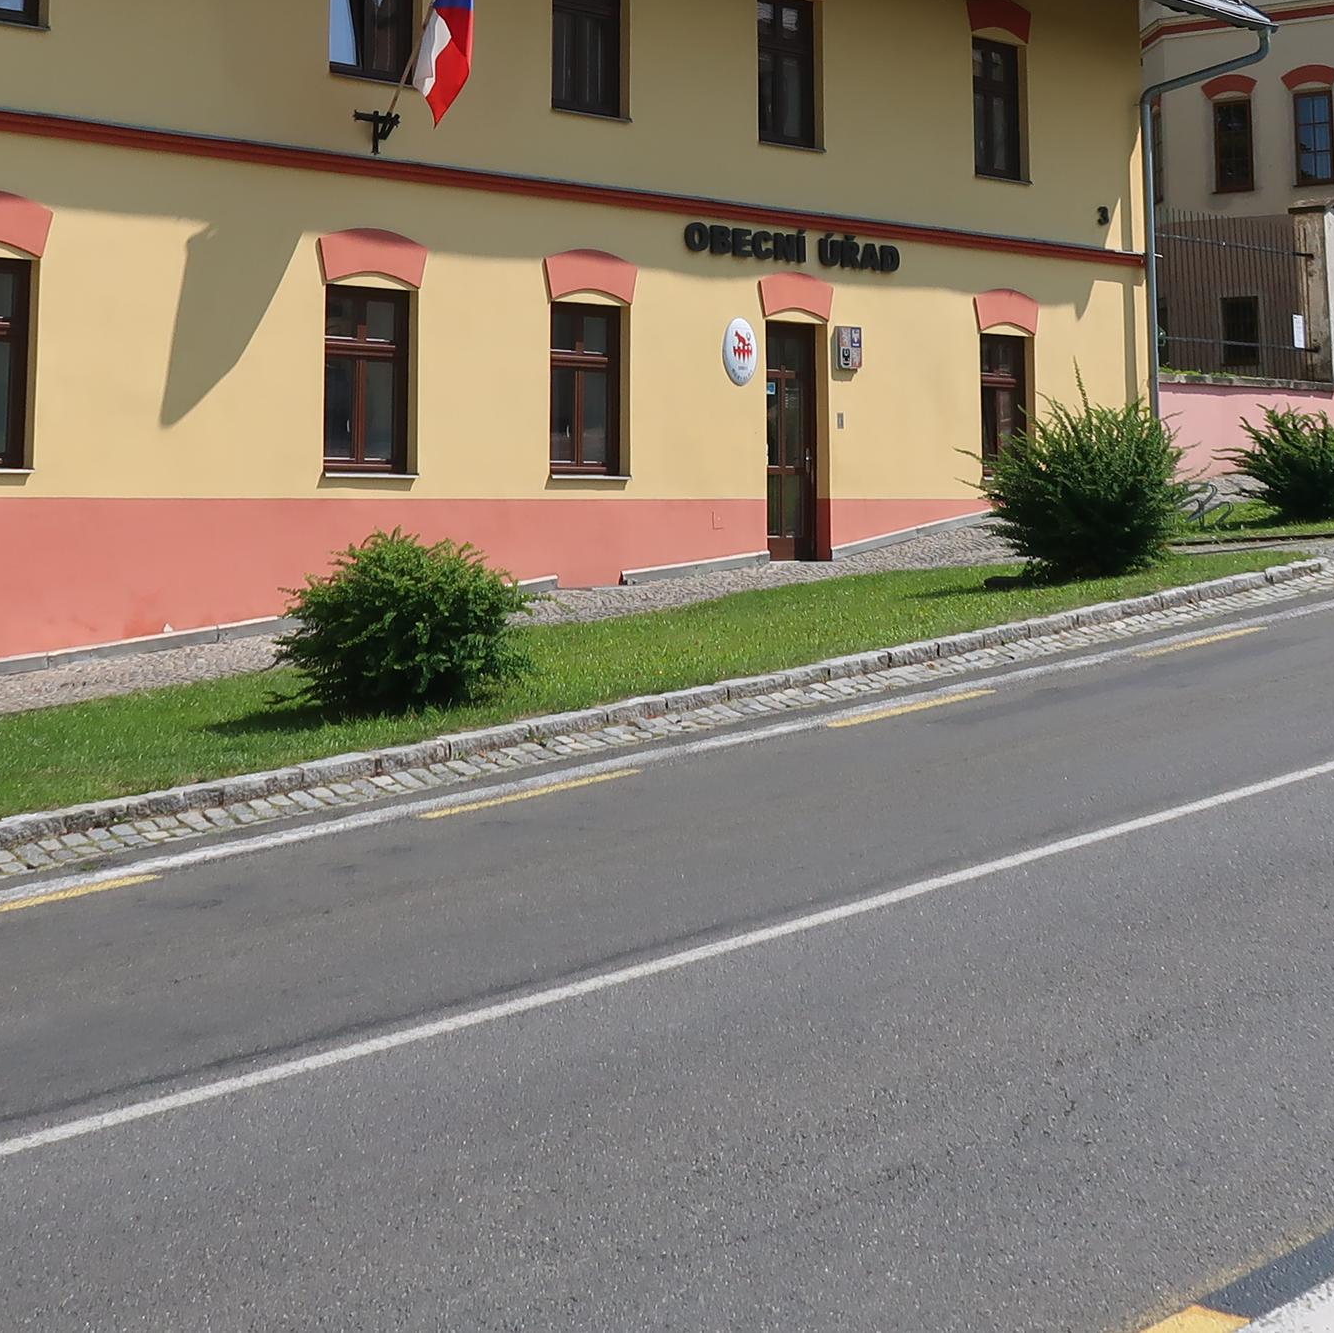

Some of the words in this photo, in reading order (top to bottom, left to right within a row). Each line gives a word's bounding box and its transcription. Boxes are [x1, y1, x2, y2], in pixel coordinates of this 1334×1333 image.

[1097, 206, 1109, 226] 3
[684, 222, 806, 263] OBECNÍ
[818, 232, 900, 272] ÚŘAD
